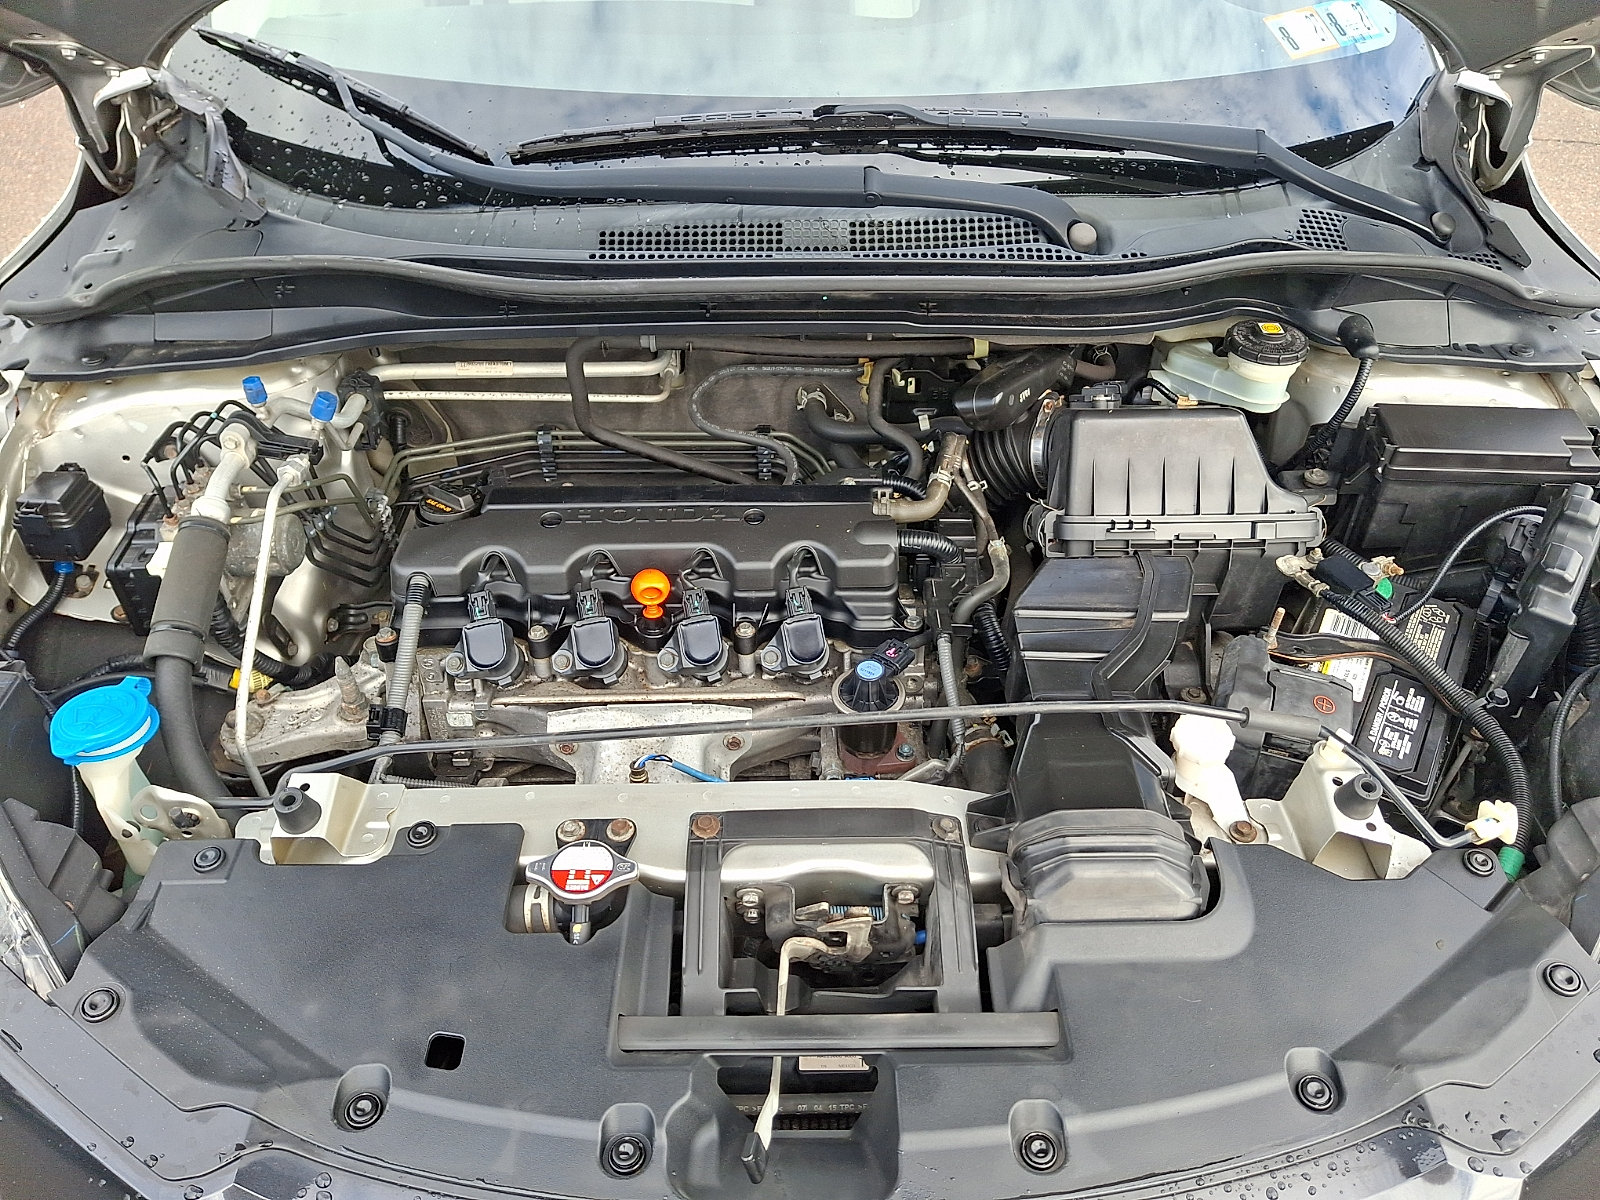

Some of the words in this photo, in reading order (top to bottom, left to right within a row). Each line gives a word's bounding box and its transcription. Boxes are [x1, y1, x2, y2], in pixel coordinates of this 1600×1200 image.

[1326, 12, 1347, 37] 8
[1278, 26, 1299, 51] 8
[563, 507, 743, 524] HONDA
[1369, 711, 1384, 737] DANGER
[1378, 686, 1392, 709] POISON
[839, 1103, 855, 1111] TPC
